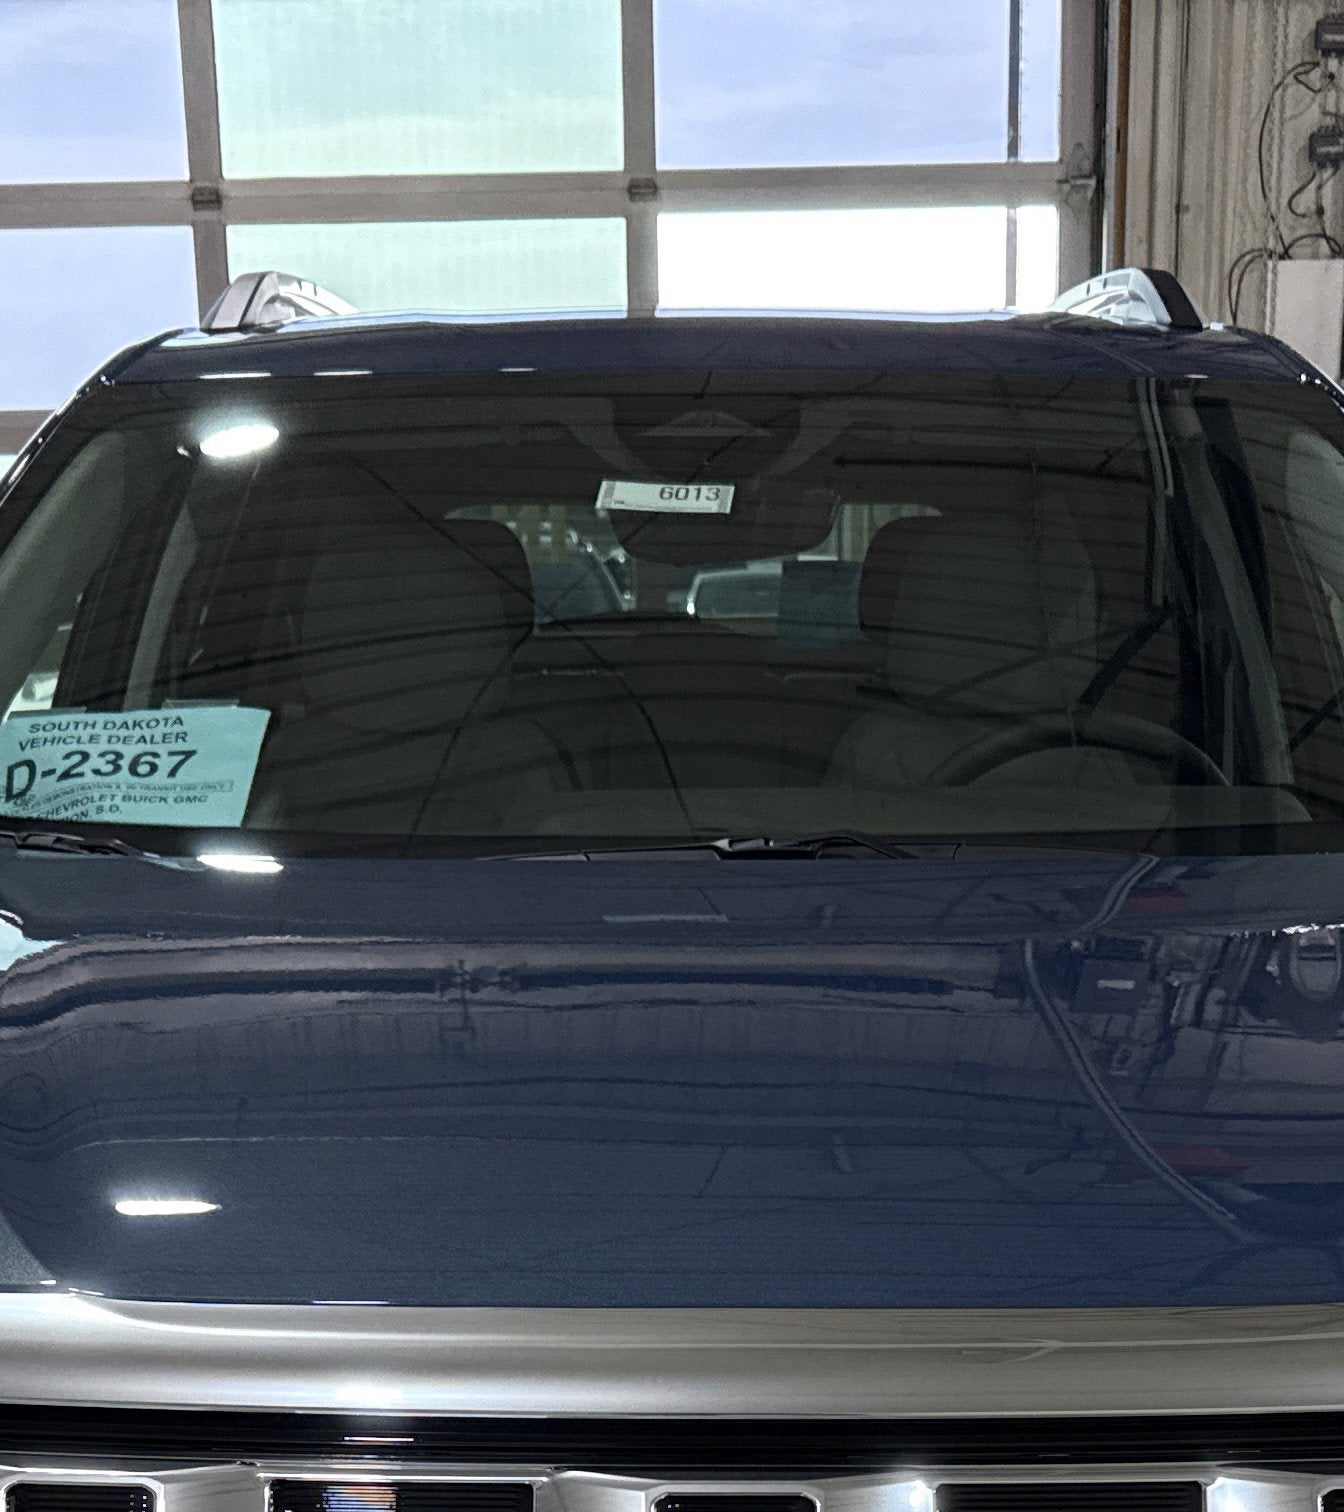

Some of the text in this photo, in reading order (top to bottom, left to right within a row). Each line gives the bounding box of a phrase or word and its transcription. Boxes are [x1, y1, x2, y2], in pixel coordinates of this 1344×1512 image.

[659, 486, 722, 502] 6013
[28, 715, 185, 734] SOUTH DAKOTA
[18, 731, 189, 752] VEHICLE DEALER
[6, 749, 198, 802] D-2367
[121, 794, 169, 804] BUICK
[173, 794, 209, 804] GMC
